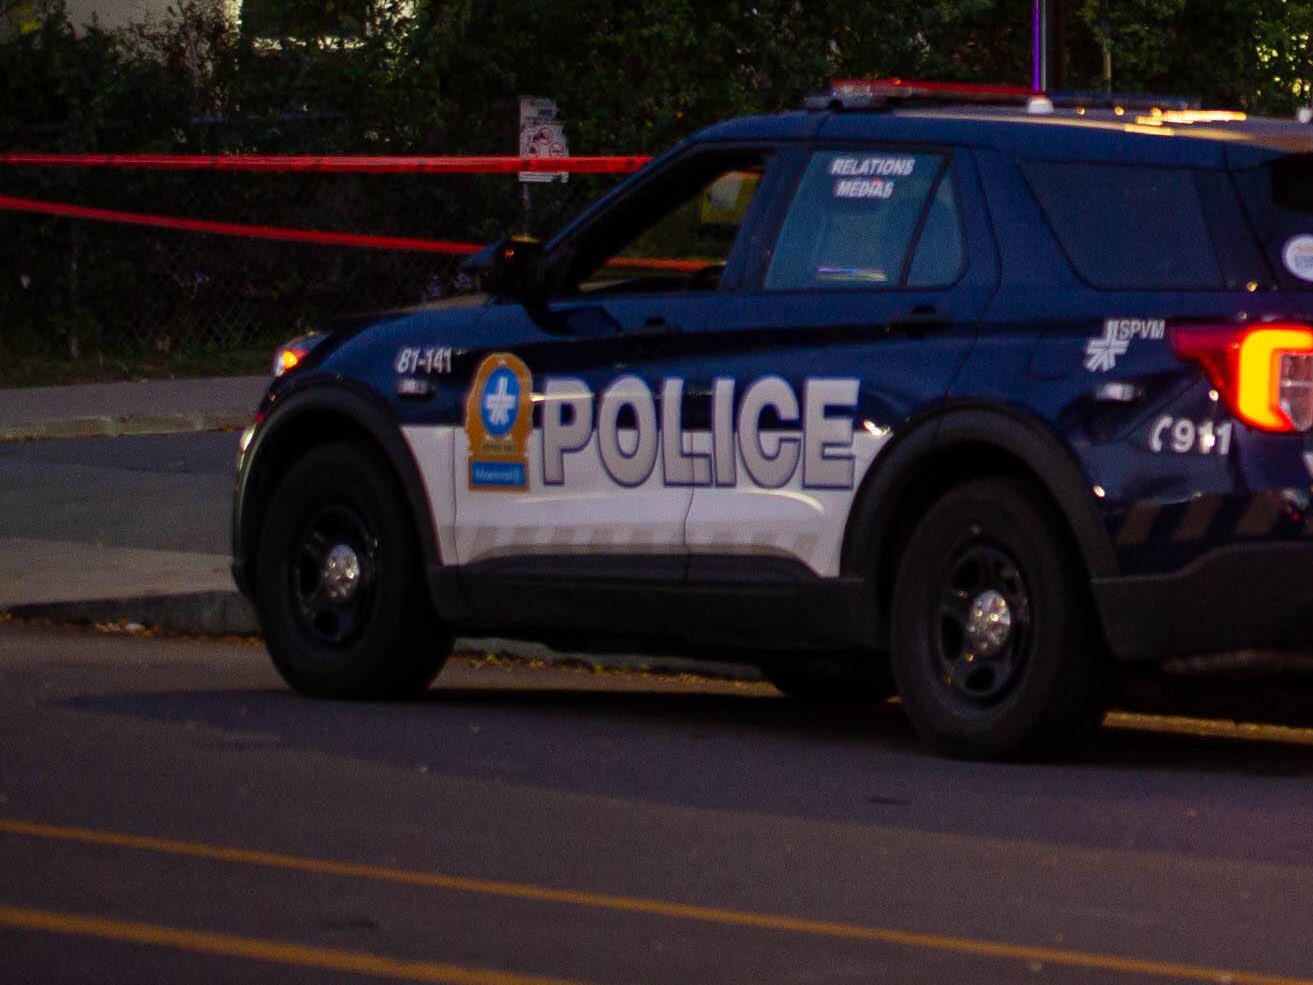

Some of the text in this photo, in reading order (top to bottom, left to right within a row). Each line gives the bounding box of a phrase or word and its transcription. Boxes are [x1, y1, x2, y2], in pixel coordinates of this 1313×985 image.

[831, 158, 916, 176] RELATIONS
[1119, 319, 1166, 340] SPVM
[396, 347, 452, 374] 81-141
[542, 375, 861, 489] POLICE
[1171, 418, 1233, 455] 911
